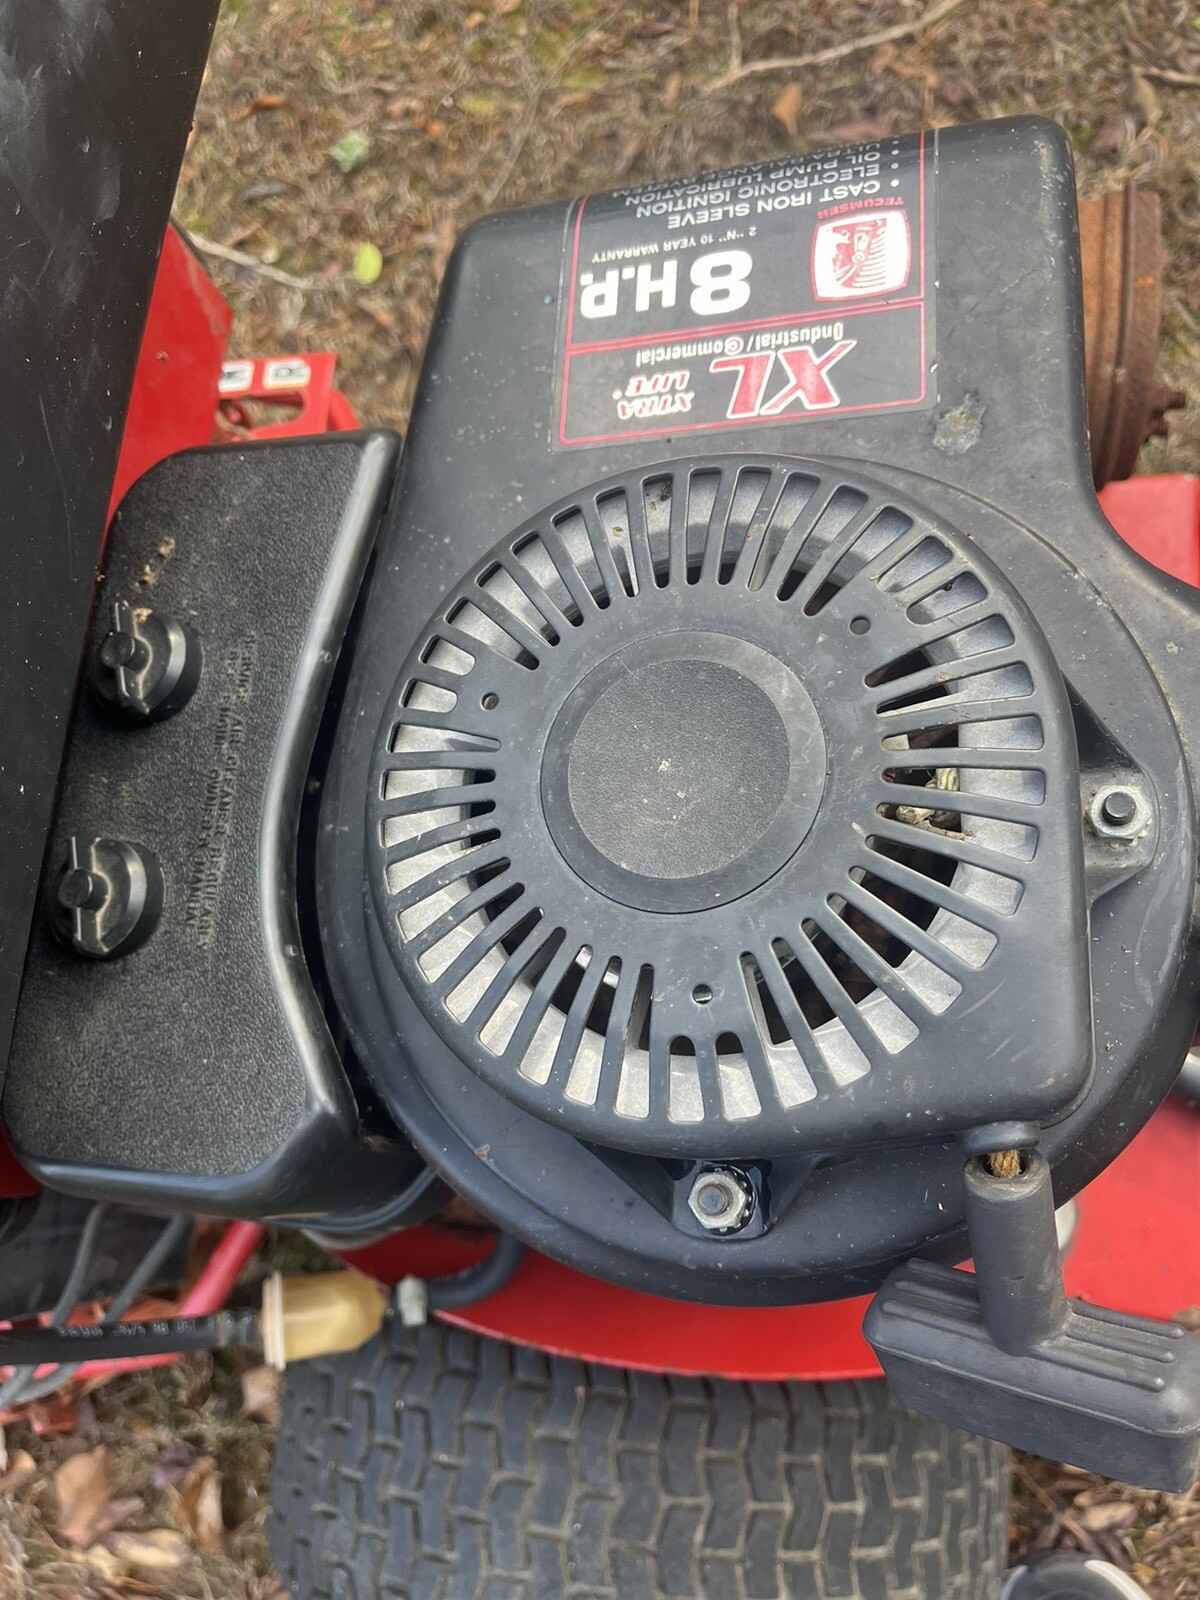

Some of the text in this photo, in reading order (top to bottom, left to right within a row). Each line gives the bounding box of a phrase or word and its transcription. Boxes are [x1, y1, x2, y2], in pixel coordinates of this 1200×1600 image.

[624, 149, 881, 208] OIL PUMP LUBRICATION
[635, 162, 881, 219] ELECTRONIC IGNITION
[666, 178, 881, 230] CAST IRON SLEEVE
[817, 196, 905, 220] TECUMSEH
[663, 235, 697, 252] YEAR
[701, 233, 715, 245] 10
[748, 226, 758, 238] 2
[592, 241, 660, 264] WARRANTY
[579, 249, 753, 319] 8 H.P.
[709, 340, 857, 419] XL
[617, 391, 695, 420] XTRA
[229, 713, 245, 745] AIR
